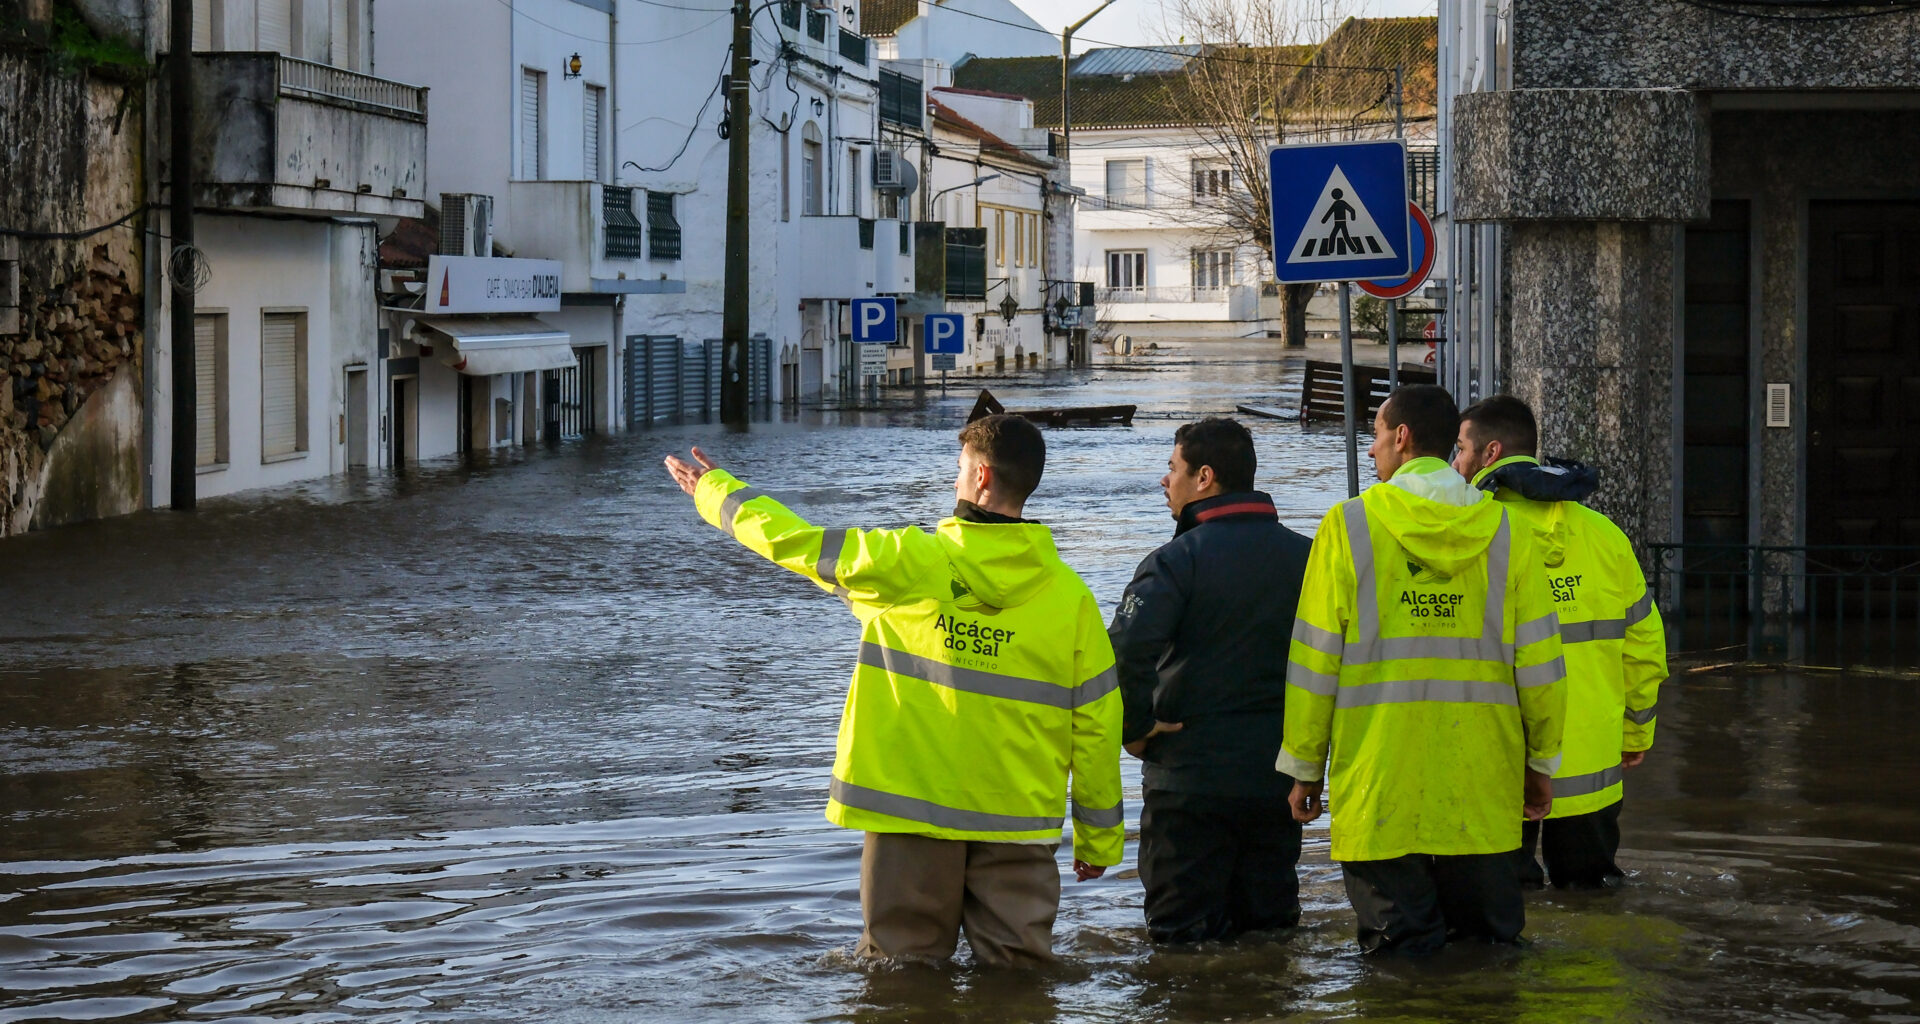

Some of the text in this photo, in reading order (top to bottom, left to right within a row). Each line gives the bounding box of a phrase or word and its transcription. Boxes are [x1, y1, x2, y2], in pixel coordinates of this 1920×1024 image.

[532, 274, 559, 299] D'ALDEIA
[860, 302, 886, 338] P
[932, 317, 956, 350] P
[1424, 330, 1436, 339] ST
[1400, 590, 1464, 605] Alcacer
[1552, 587, 1576, 603] Sal
[1410, 604, 1456, 618] do Sal
[934, 613, 1016, 644] Alcácer
[944, 634, 999, 657] do Sal
